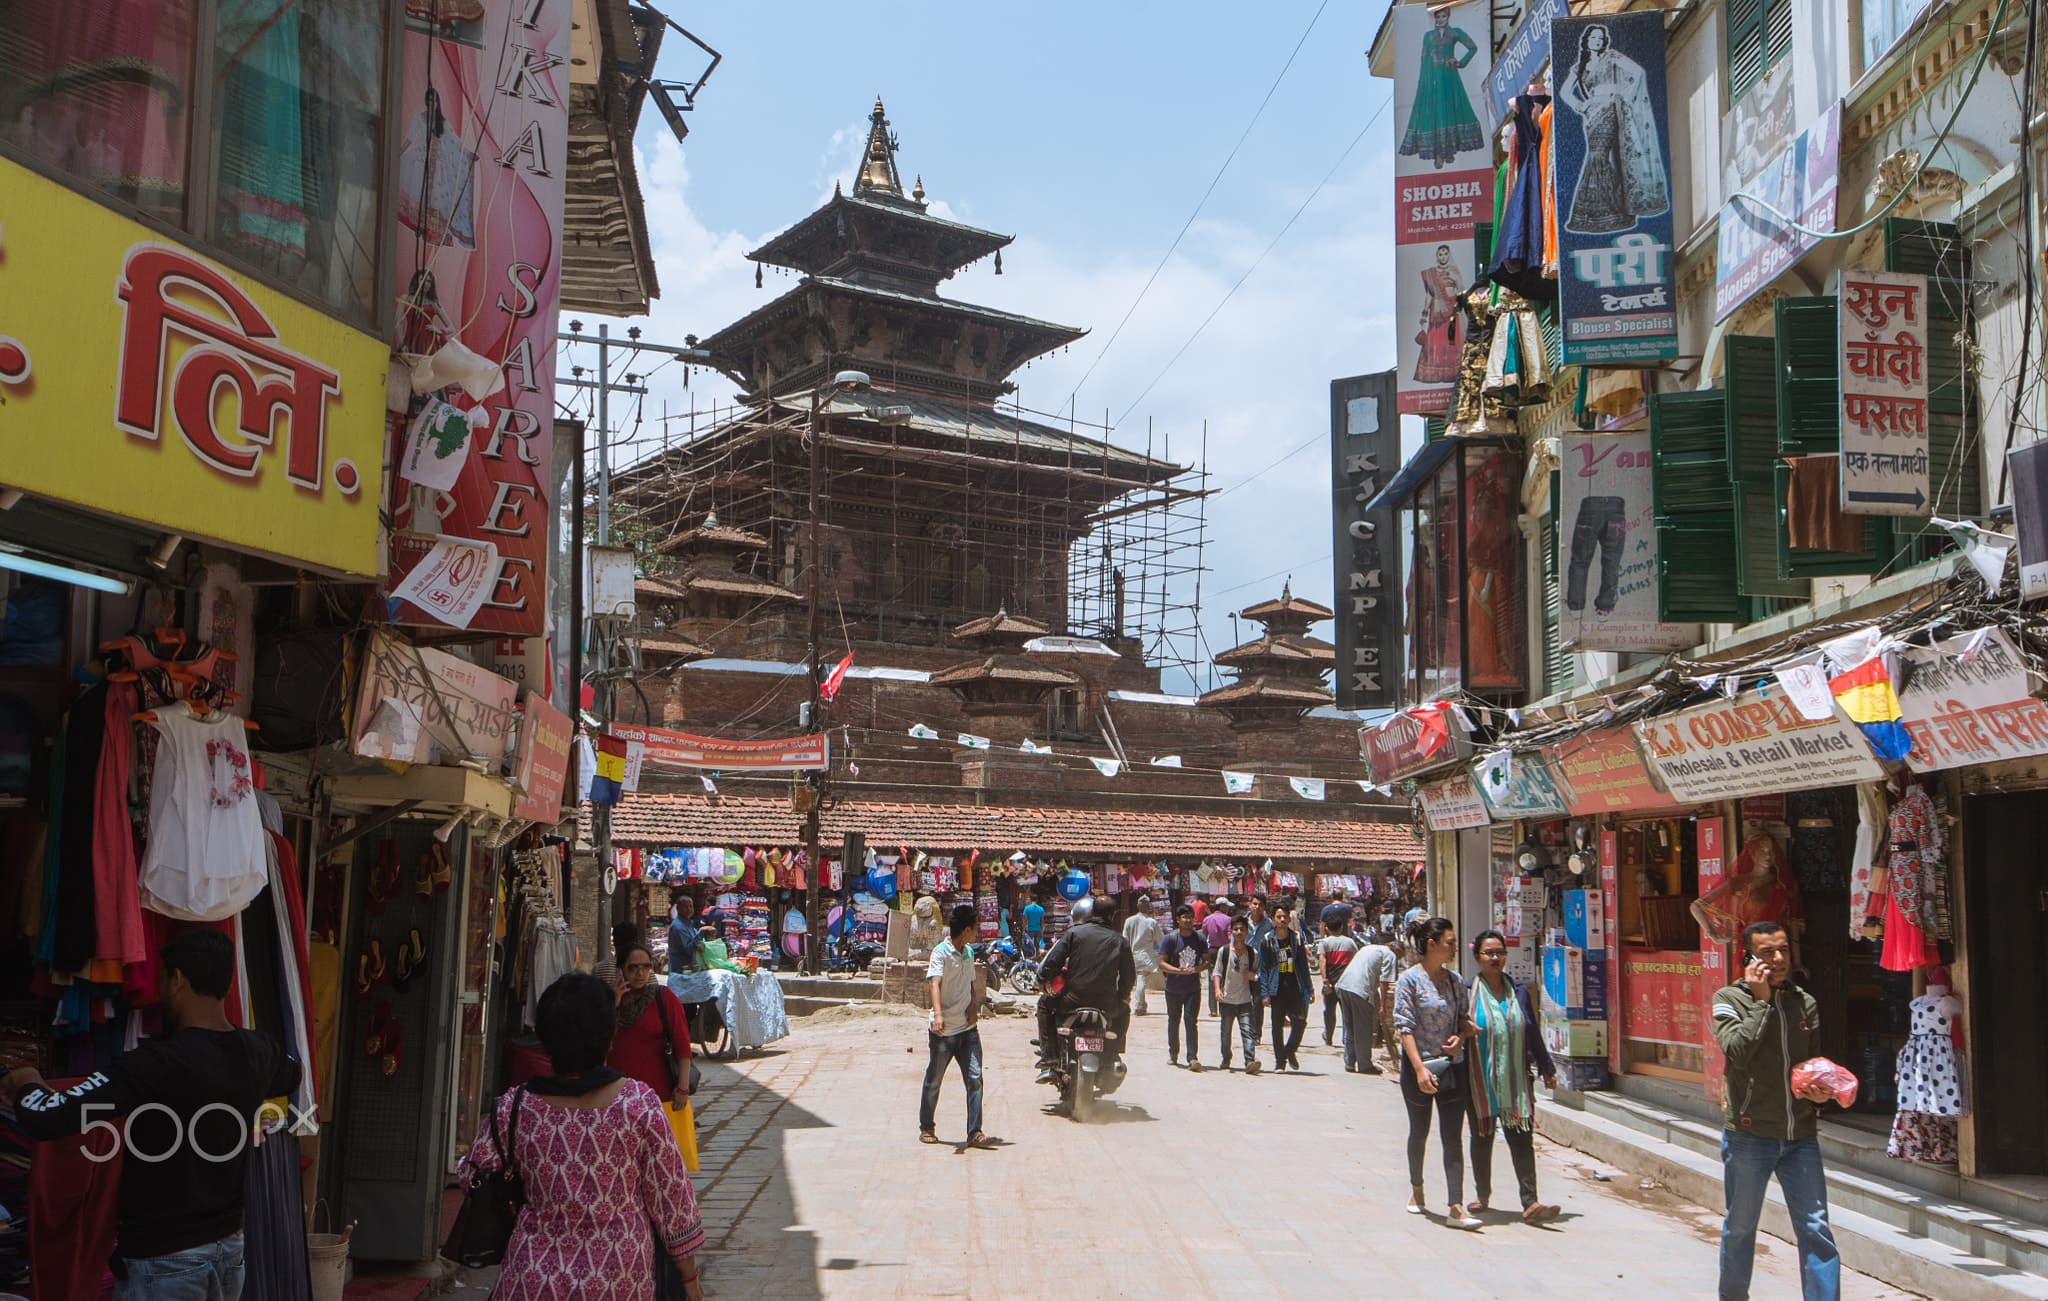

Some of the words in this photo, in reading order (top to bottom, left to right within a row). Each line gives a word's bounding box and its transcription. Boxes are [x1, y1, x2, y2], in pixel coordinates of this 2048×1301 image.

[1402, 181, 1482, 202] SHOBHA
[1411, 202, 1473, 222] SAREE
[1570, 233, 1670, 289] परी
[1716, 267, 1760, 313] Blouse
[1760, 196, 1834, 269] Specialist
[1847, 281, 1920, 329] सुन
[1571, 321, 1612, 335] Blouse
[1615, 317, 1673, 333] Specialist
[1846, 329, 1923, 386] चाँदी
[1844, 392, 1926, 436] पसल
[1845, 450, 1869, 477] एक
[1636, 539, 1649, 553] A
[1597, 622, 1638, 635] Complex
[1629, 635, 1667, 646] Makhan
[1658, 751, 1726, 779] Wholesale
[1729, 751, 1739, 768] &
[1742, 748, 1789, 770] Retail
[1791, 730, 1855, 760] Market
